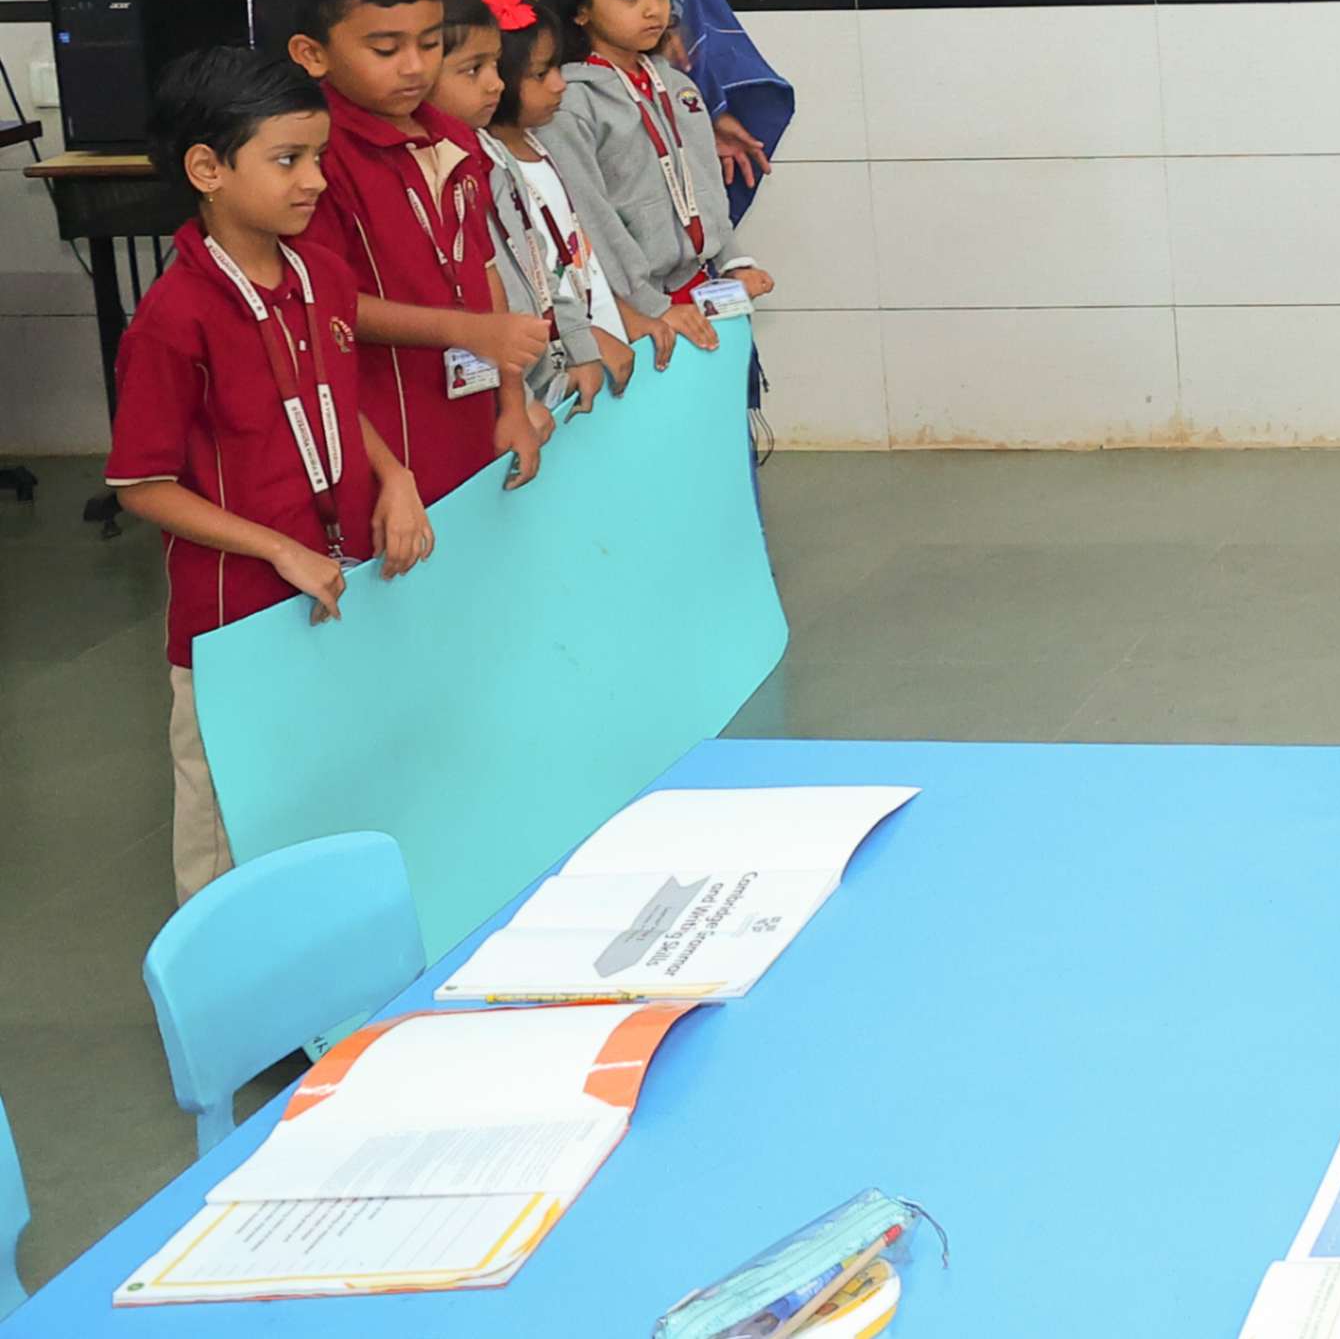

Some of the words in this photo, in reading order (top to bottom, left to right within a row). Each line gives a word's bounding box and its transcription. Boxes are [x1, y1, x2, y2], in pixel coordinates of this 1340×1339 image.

[701, 882, 725, 905] and
[704, 871, 759, 930] Cambridge
[664, 903, 714, 941] Writing
[645, 939, 681, 968] Skills
